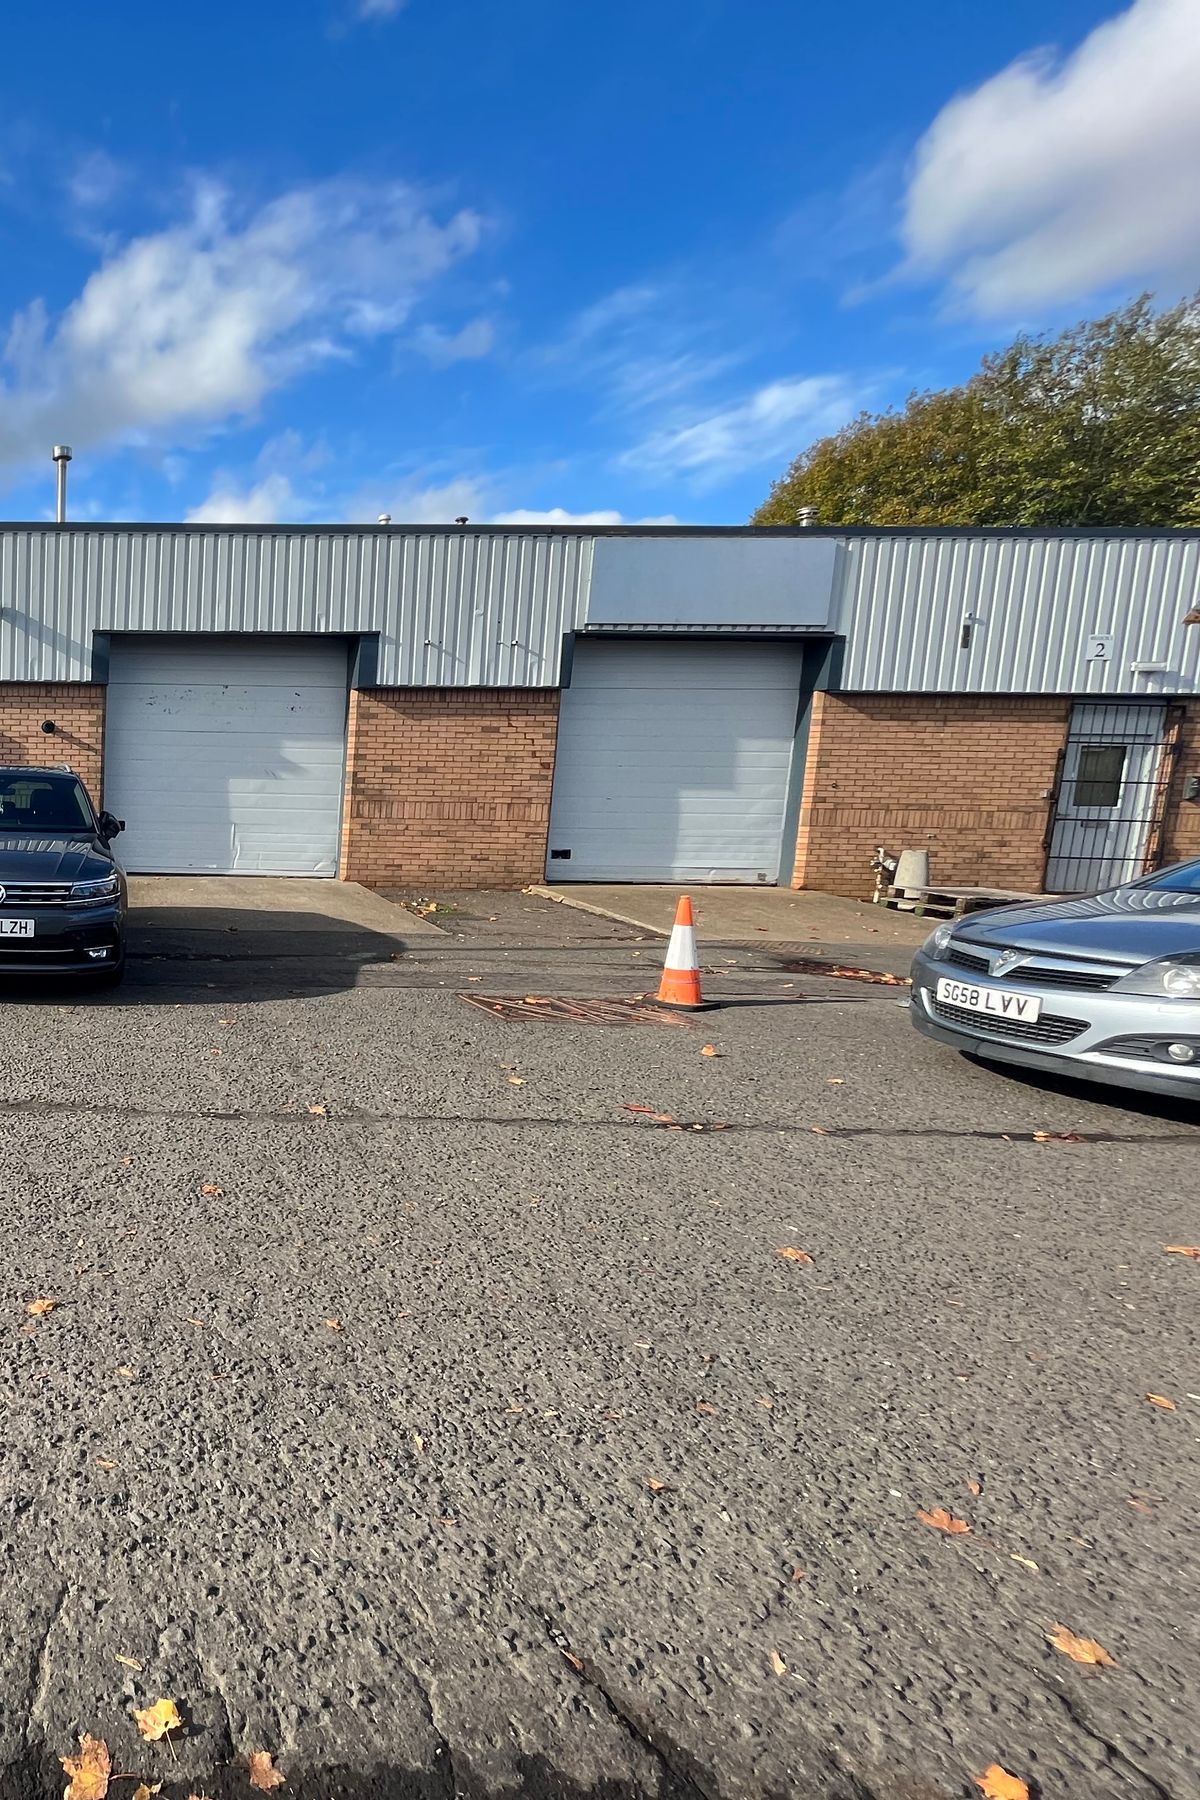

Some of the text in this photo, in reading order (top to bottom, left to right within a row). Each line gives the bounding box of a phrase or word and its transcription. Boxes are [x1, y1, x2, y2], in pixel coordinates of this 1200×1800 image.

[1094, 642, 1106, 658] 2
[0, 920, 28, 934] LZH
[943, 982, 1029, 1016] SG58 LVV
